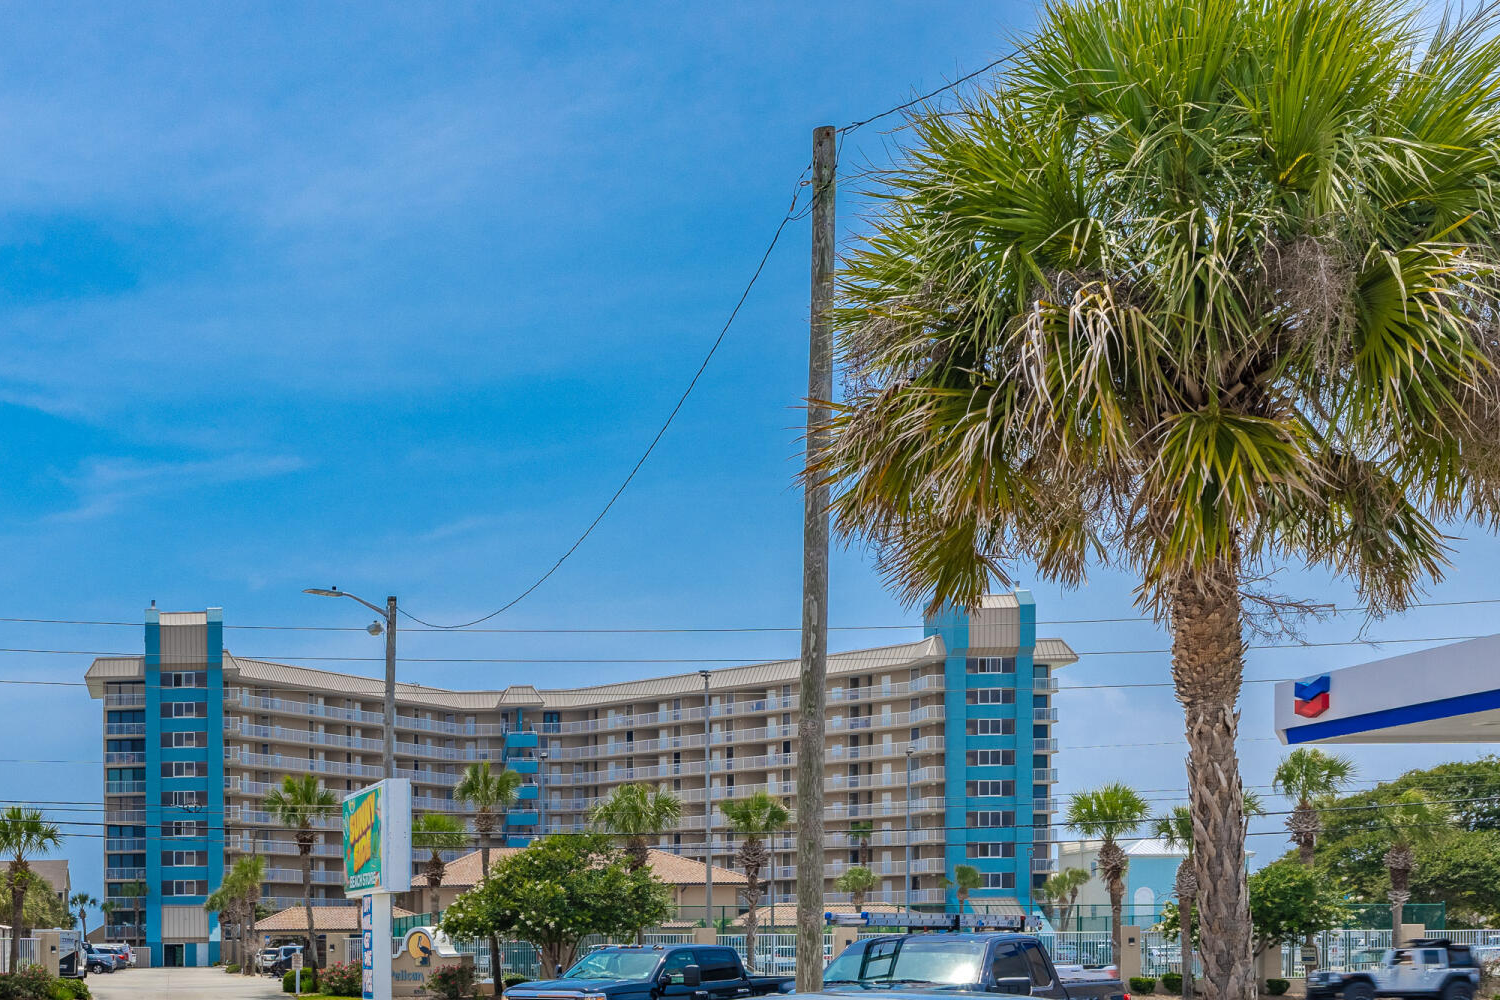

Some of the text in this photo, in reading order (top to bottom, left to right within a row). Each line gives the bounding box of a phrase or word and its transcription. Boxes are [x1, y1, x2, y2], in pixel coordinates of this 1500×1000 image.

[349, 791, 375, 846] SUNNY
[349, 871, 376, 889] BEACH STORE
